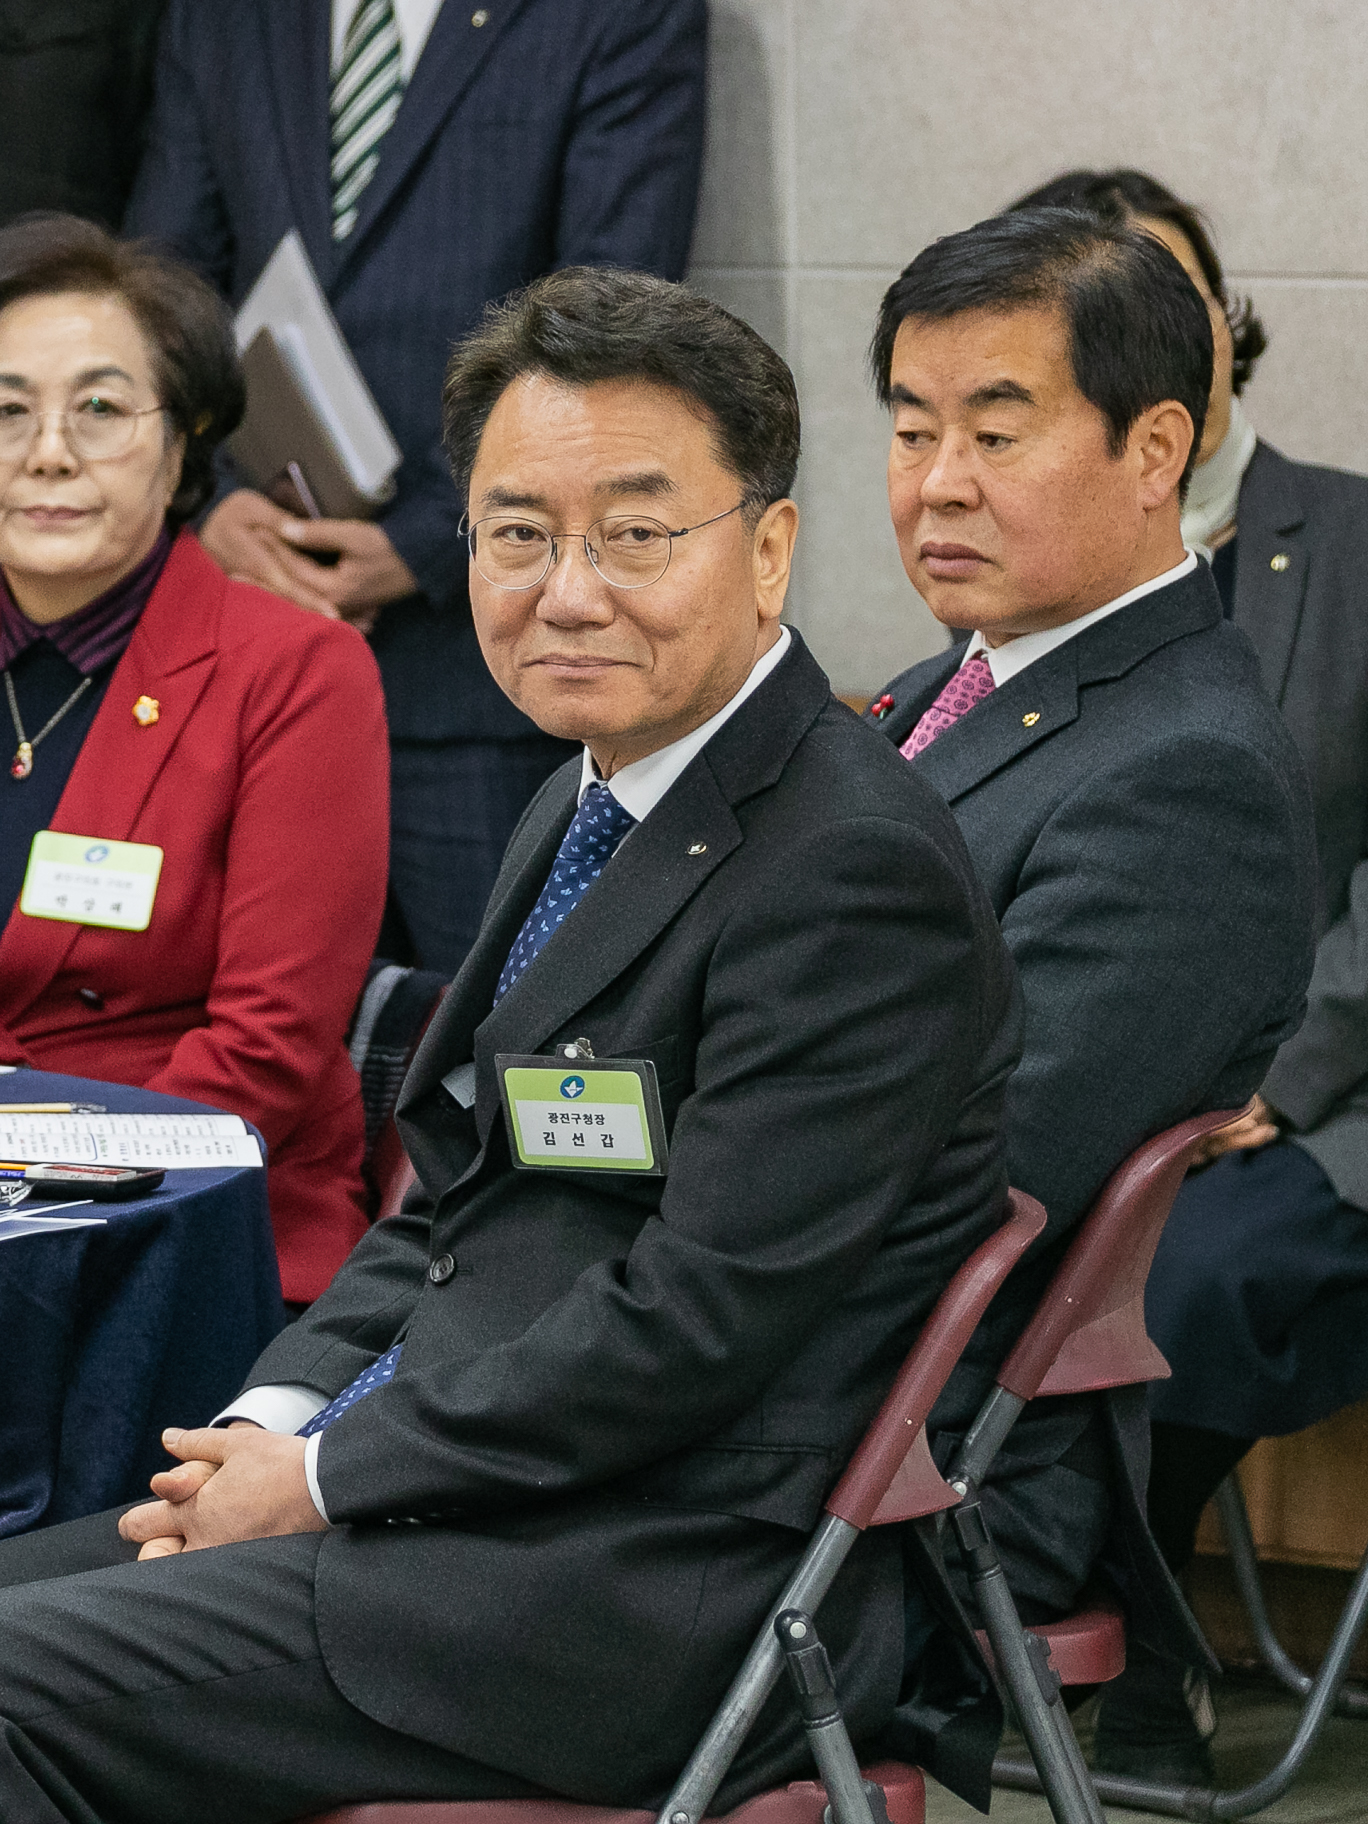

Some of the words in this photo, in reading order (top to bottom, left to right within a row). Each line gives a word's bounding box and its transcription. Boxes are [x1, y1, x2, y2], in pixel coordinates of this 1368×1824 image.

[547, 1112, 605, 1126] 광진구청장
[542, 1131, 556, 1146] 김
[572, 1132, 585, 1147] 선
[600, 1133, 614, 1148] 갑
